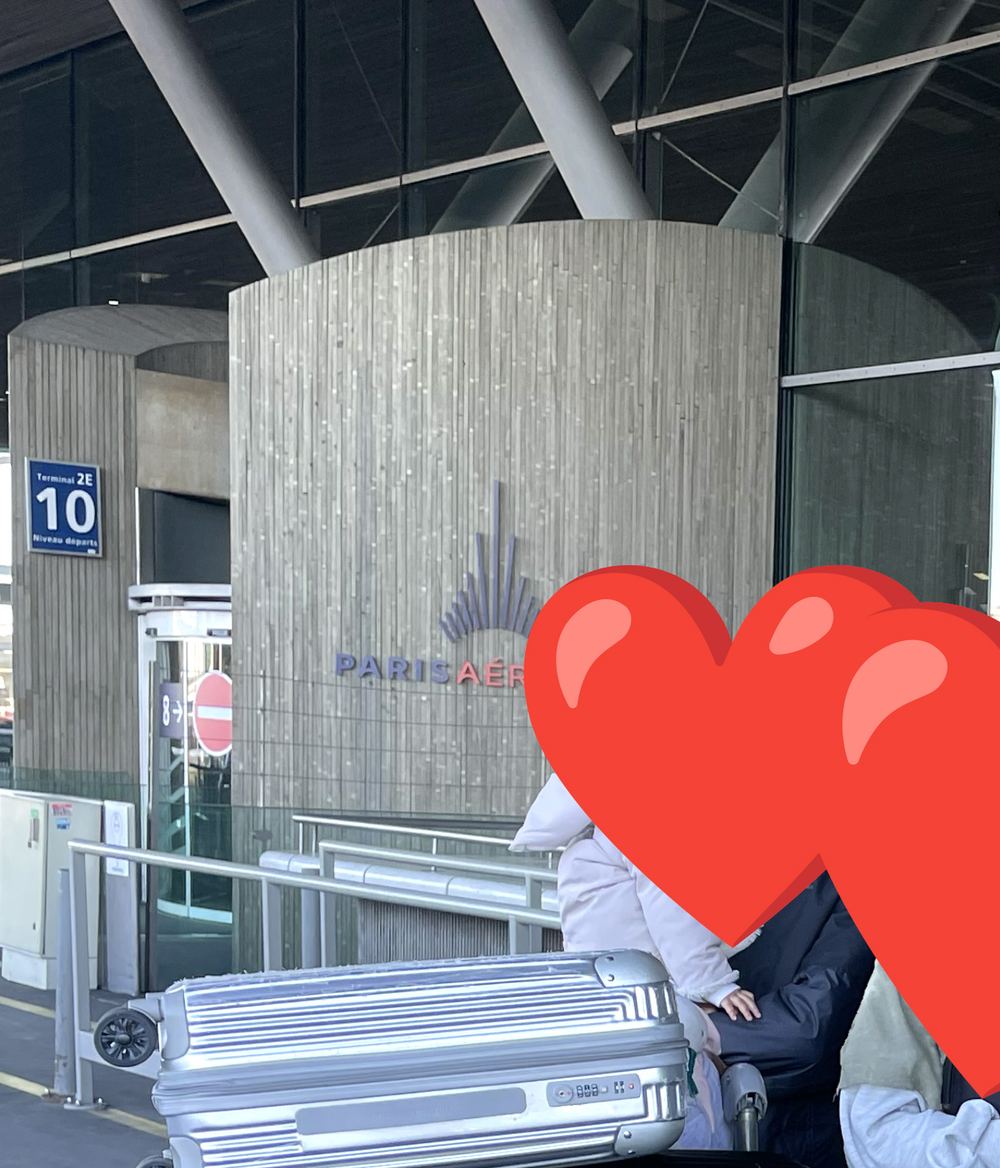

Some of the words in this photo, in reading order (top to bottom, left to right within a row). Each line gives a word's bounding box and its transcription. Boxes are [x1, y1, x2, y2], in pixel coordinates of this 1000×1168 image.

[37, 473, 75, 485] Terminal
[76, 473, 93, 486] 2E
[36, 487, 96, 534] 10
[33, 534, 64, 545] Niveau
